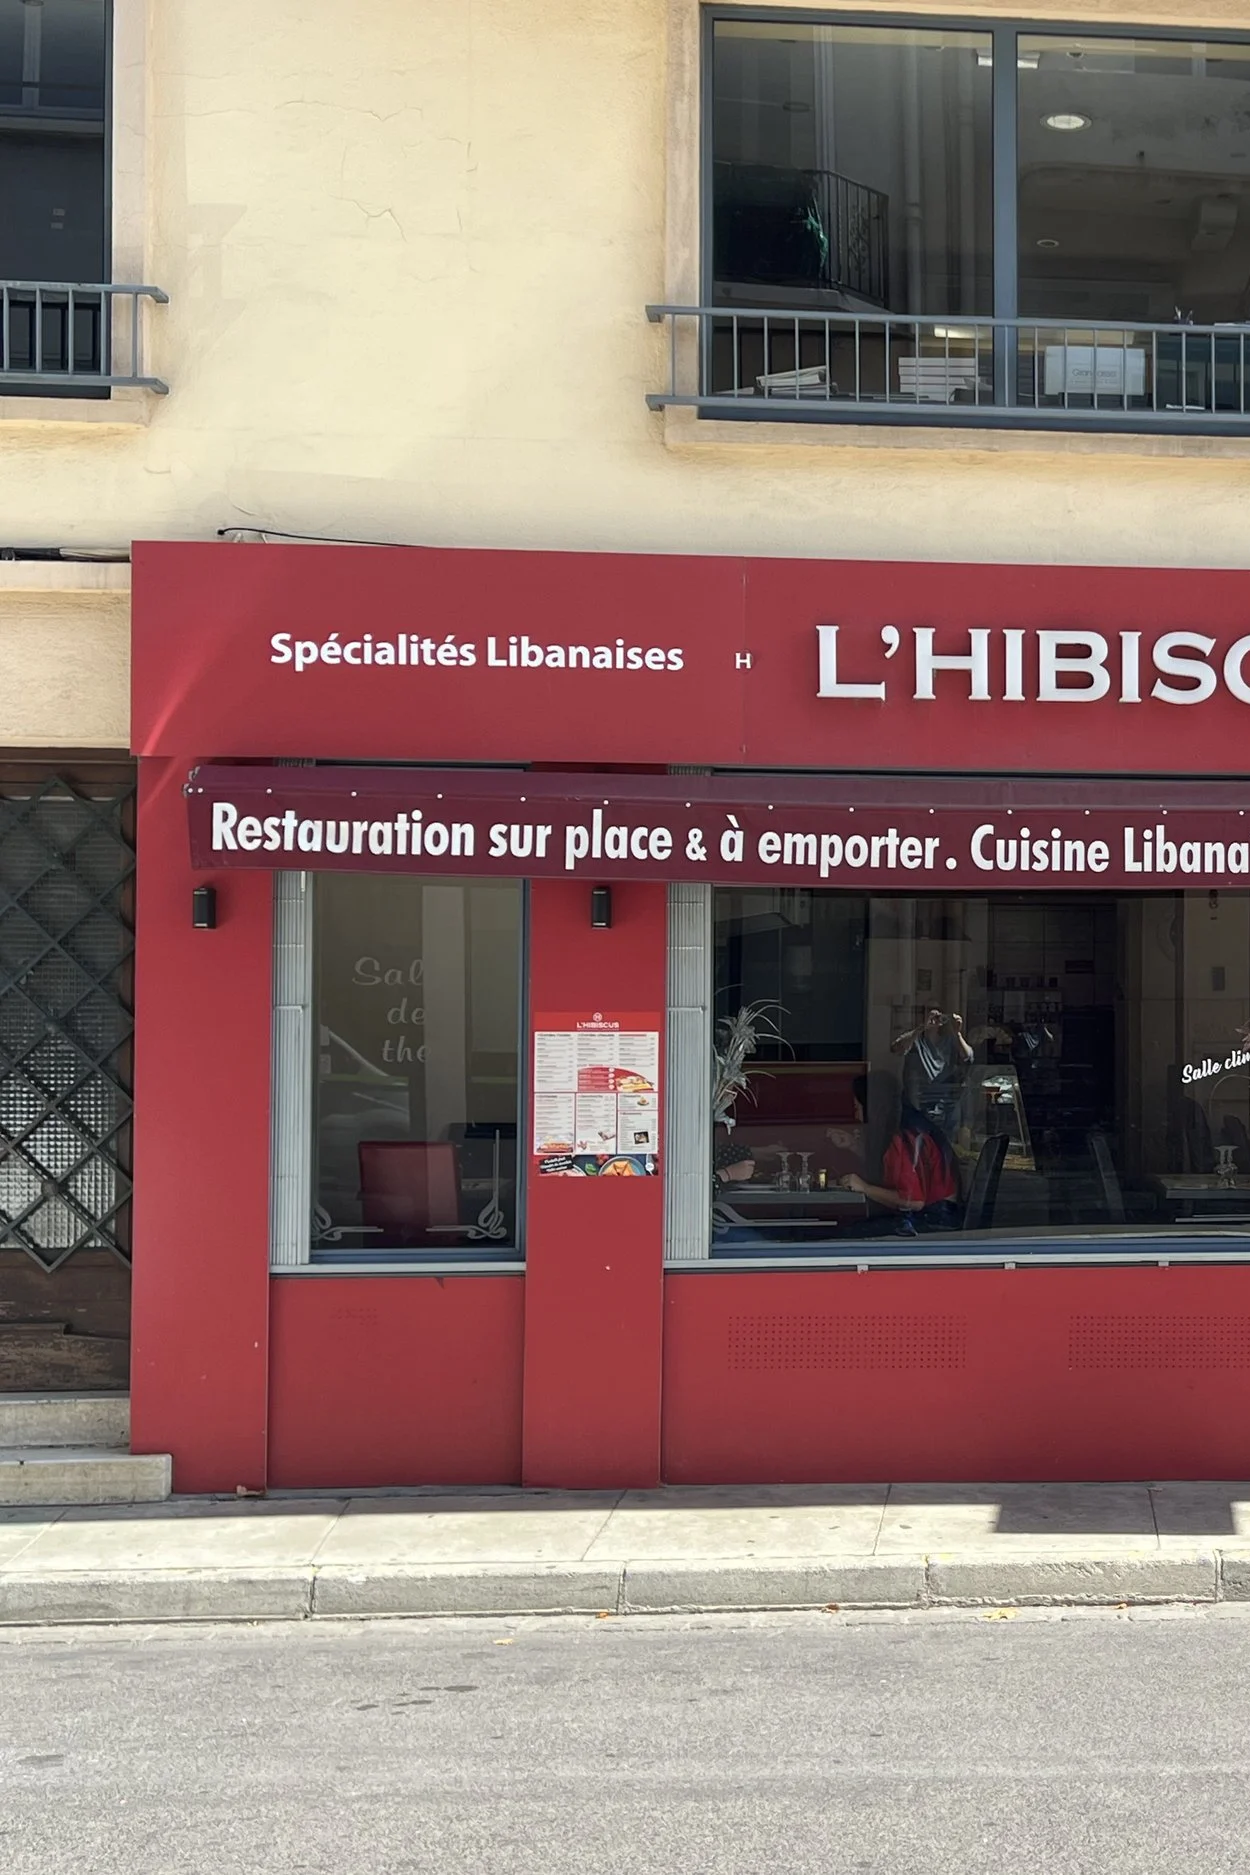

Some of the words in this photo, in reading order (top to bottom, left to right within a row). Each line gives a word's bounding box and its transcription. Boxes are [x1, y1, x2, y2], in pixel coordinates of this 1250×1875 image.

[271, 633, 476, 671] Spécialités
[488, 636, 683, 670] Libanaises
[736, 653, 750, 668] H
[213, 803, 474, 855] Restauration
[489, 824, 551, 857] sur
[566, 809, 672, 869] place
[686, 829, 706, 860] &
[721, 815, 743, 861] à
[971, 825, 1109, 872] Cuisine
[352, 956, 425, 986] Sal
[1181, 1059, 1223, 1084] Salle
